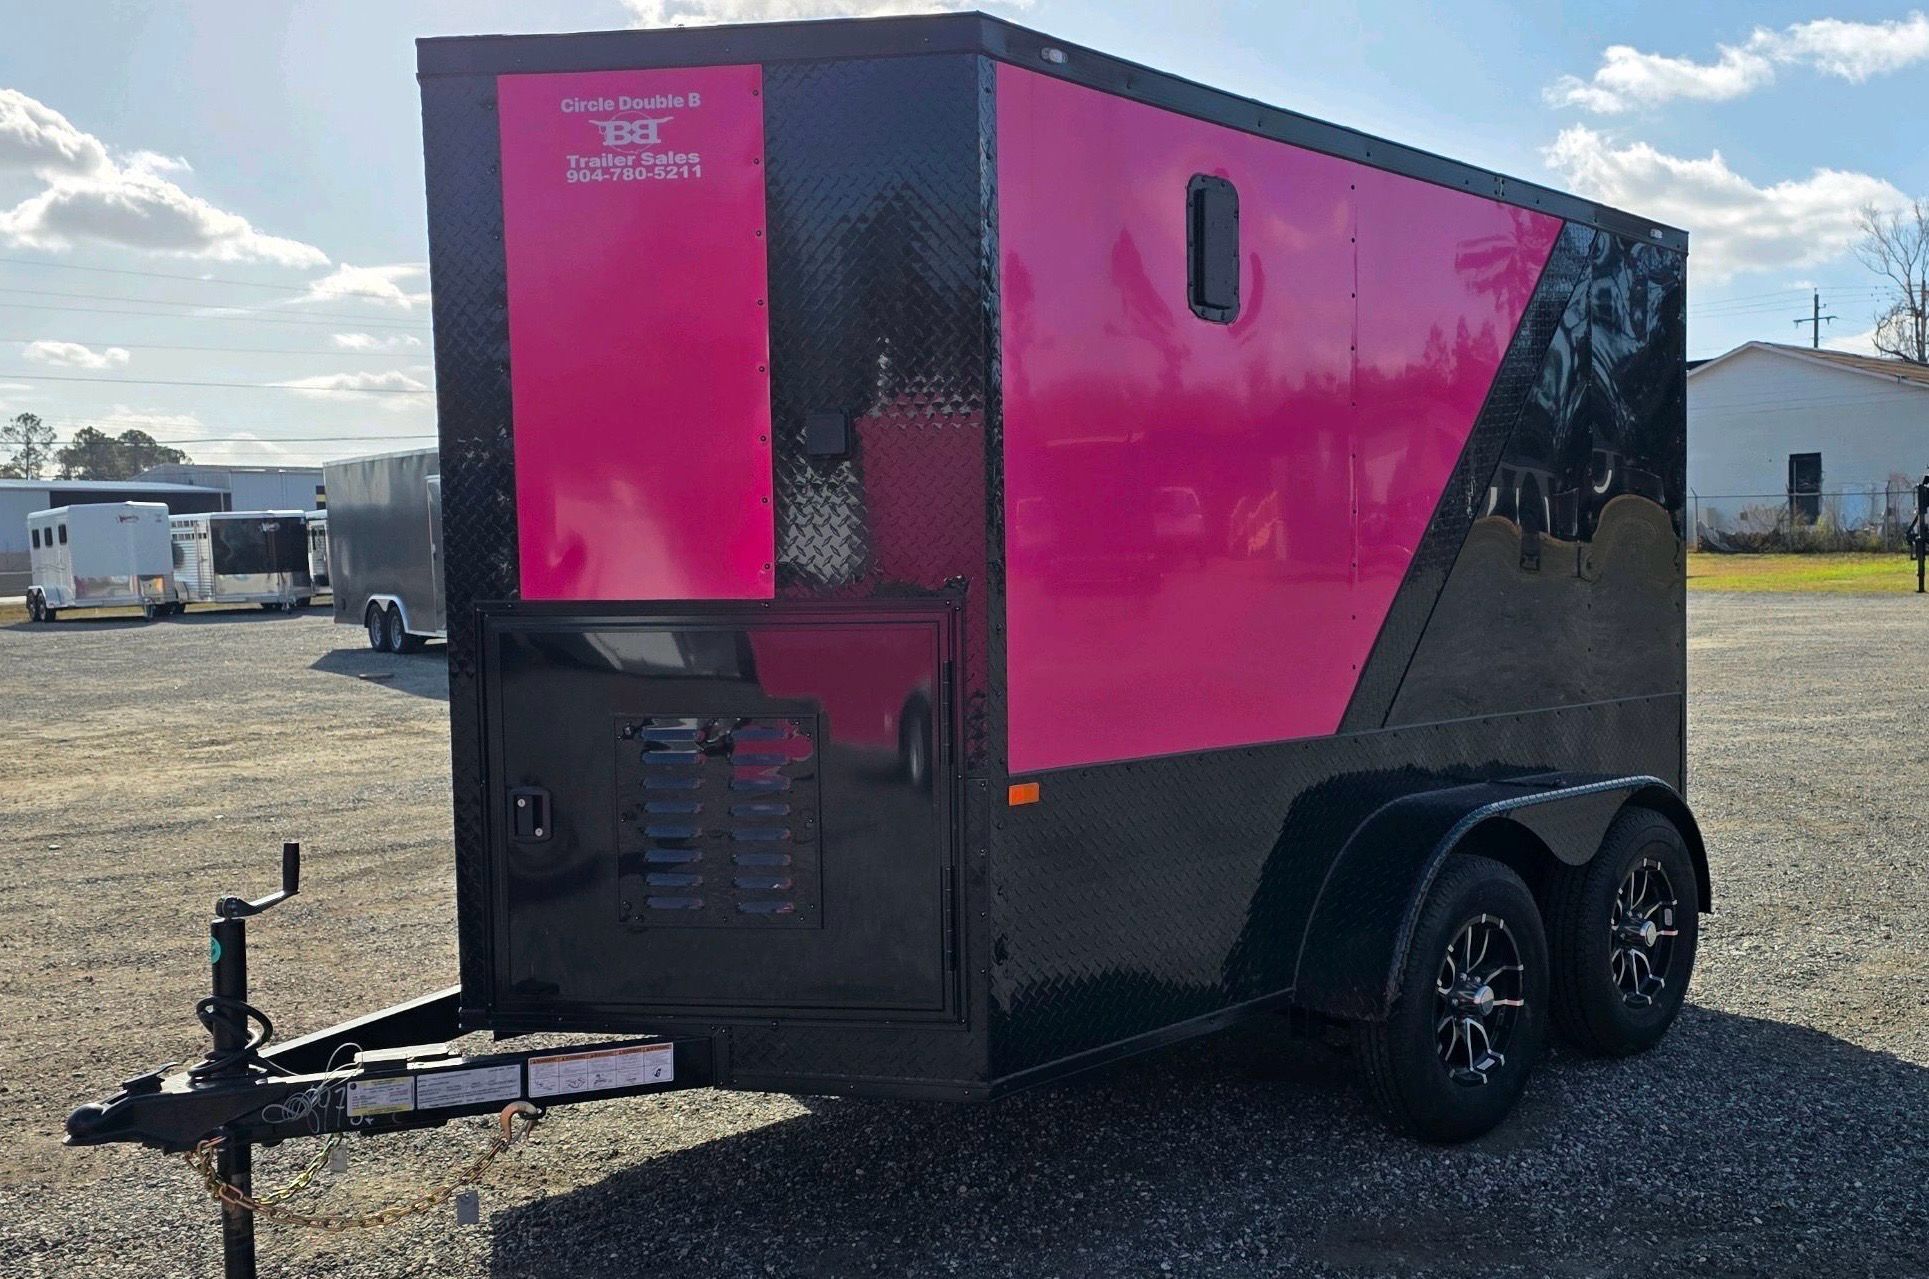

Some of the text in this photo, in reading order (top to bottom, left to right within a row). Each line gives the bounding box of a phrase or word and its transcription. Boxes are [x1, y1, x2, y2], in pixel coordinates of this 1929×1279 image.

[560, 92, 701, 113] Circle Double B
[566, 151, 700, 168] Trailer Sales
[566, 164, 702, 183] 904-780-5211
